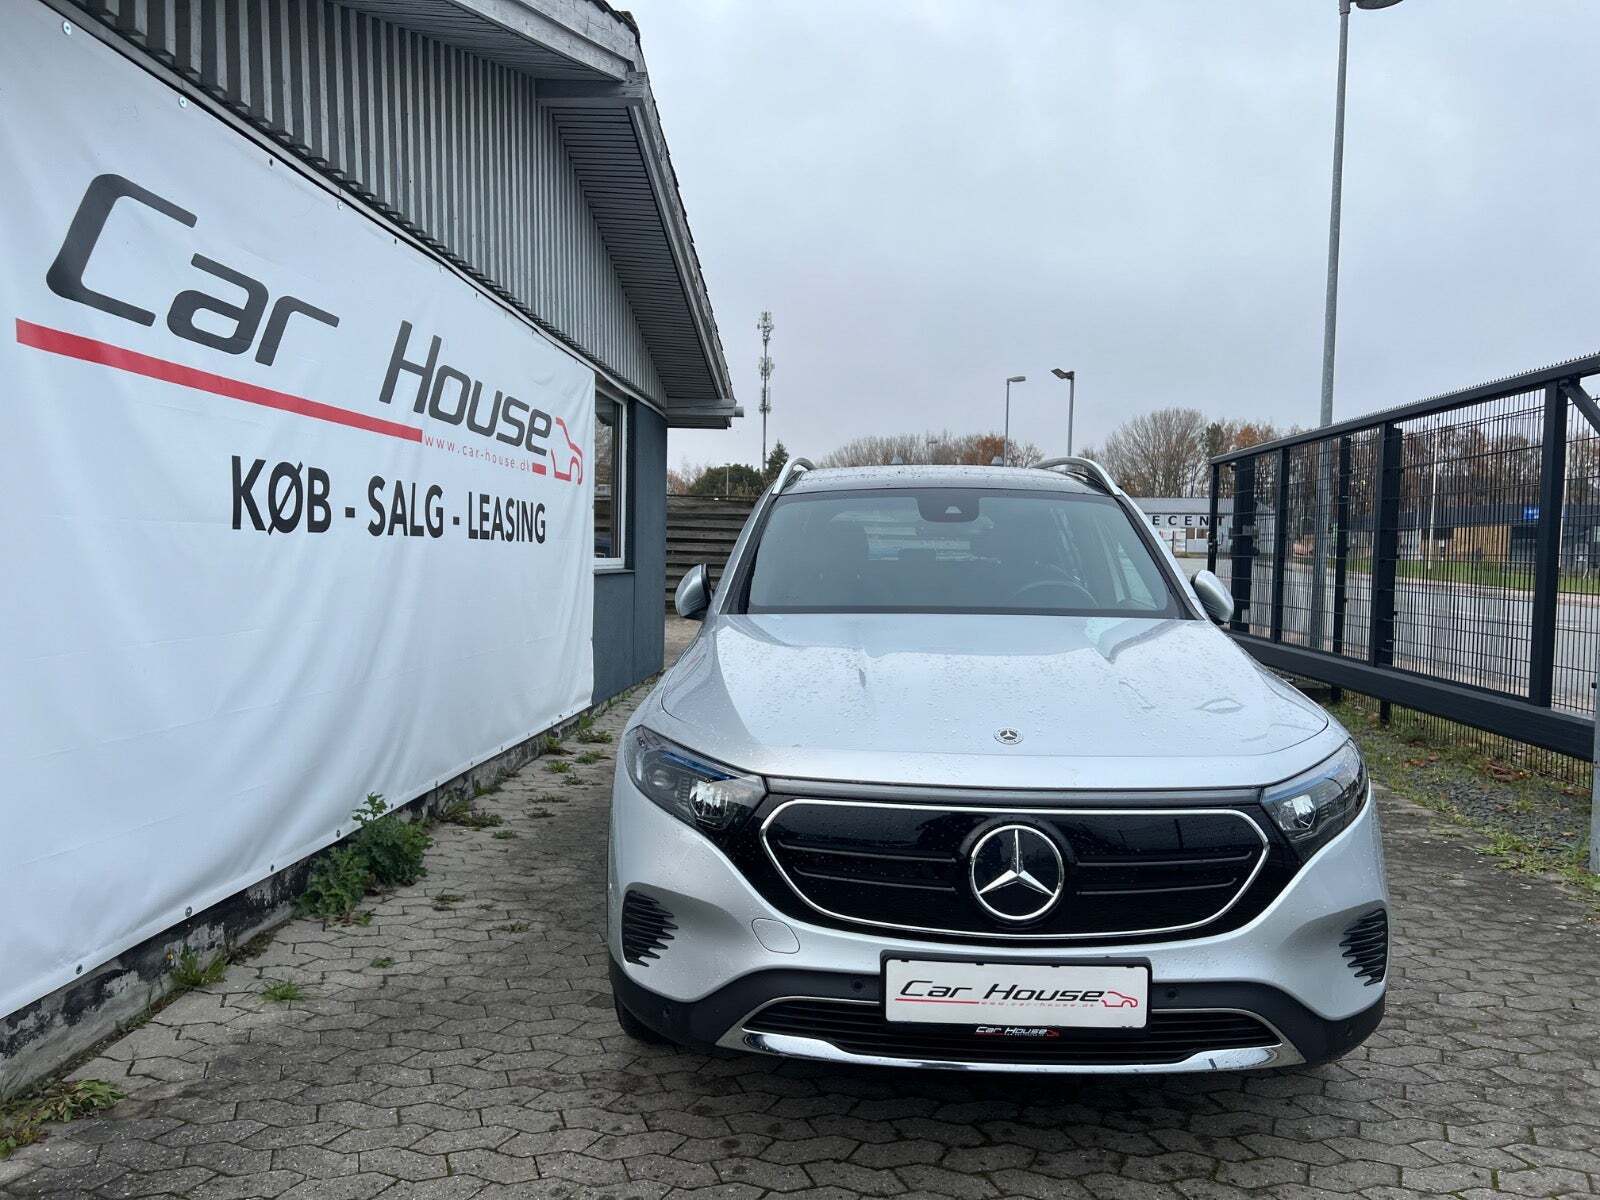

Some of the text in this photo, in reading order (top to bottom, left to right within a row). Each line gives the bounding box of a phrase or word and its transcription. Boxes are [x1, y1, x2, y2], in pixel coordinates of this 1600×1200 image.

[46, 173, 552, 457] Car House
[231, 455, 332, 536] KØB
[367, 475, 444, 539] SALG
[468, 491, 546, 544] LEASING
[900, 980, 1105, 1001] Car House
[975, 1026, 1002, 1034] Car
